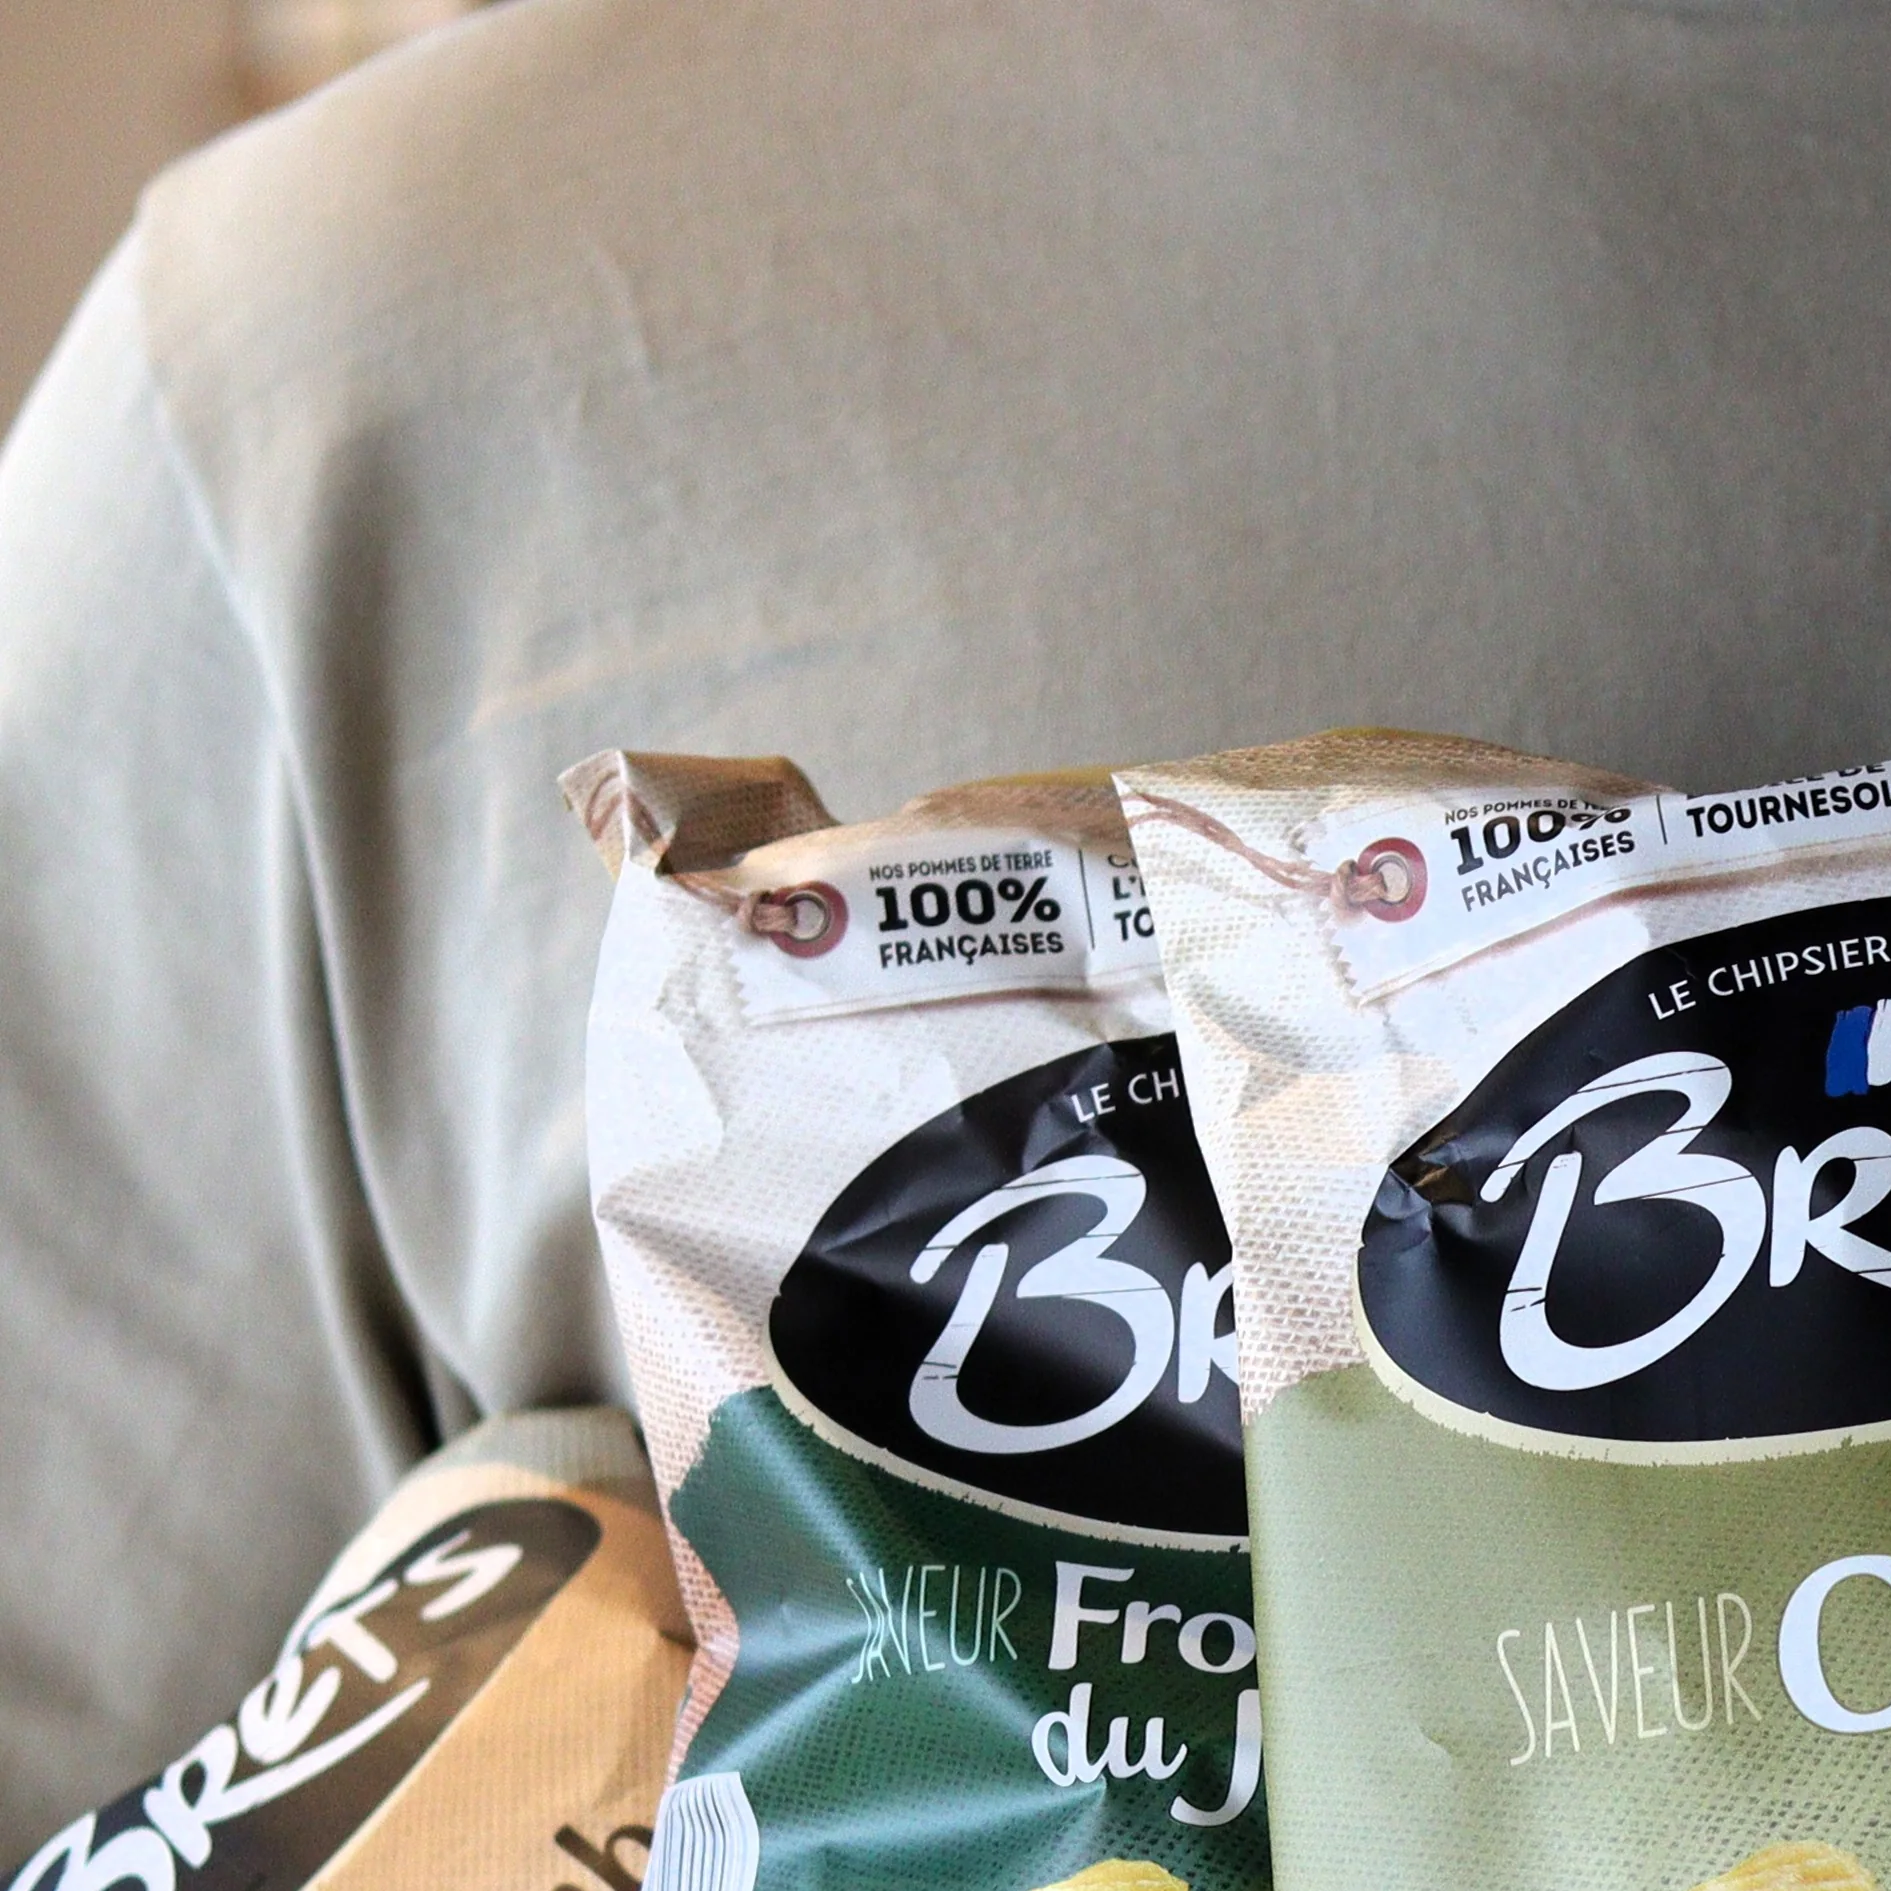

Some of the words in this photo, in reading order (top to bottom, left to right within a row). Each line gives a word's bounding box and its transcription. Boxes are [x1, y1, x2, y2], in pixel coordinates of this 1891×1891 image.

[1444, 807, 1479, 826] NOS
[1482, 799, 1553, 815] POMMES
[1557, 798, 1579, 810] DE
[1449, 807, 1632, 877] 100%
[868, 863, 905, 881] NOS
[907, 855, 977, 878] POMMES
[980, 853, 1000, 872] DE
[1004, 849, 1054, 872] TERRE
[1460, 830, 1636, 912] FRANÇAISES
[874, 875, 1062, 932] 100%
[878, 931, 1065, 968] FRANÇAISES
[1647, 979, 1697, 1021] LE
[1706, 934, 1891, 997] CHIPSIER
[1069, 1084, 1117, 1124] LE
[1047, 1559, 1257, 1674] Fro
[1495, 1591, 1763, 1768] SAVEUR
[1030, 1681, 1188, 1788] du
